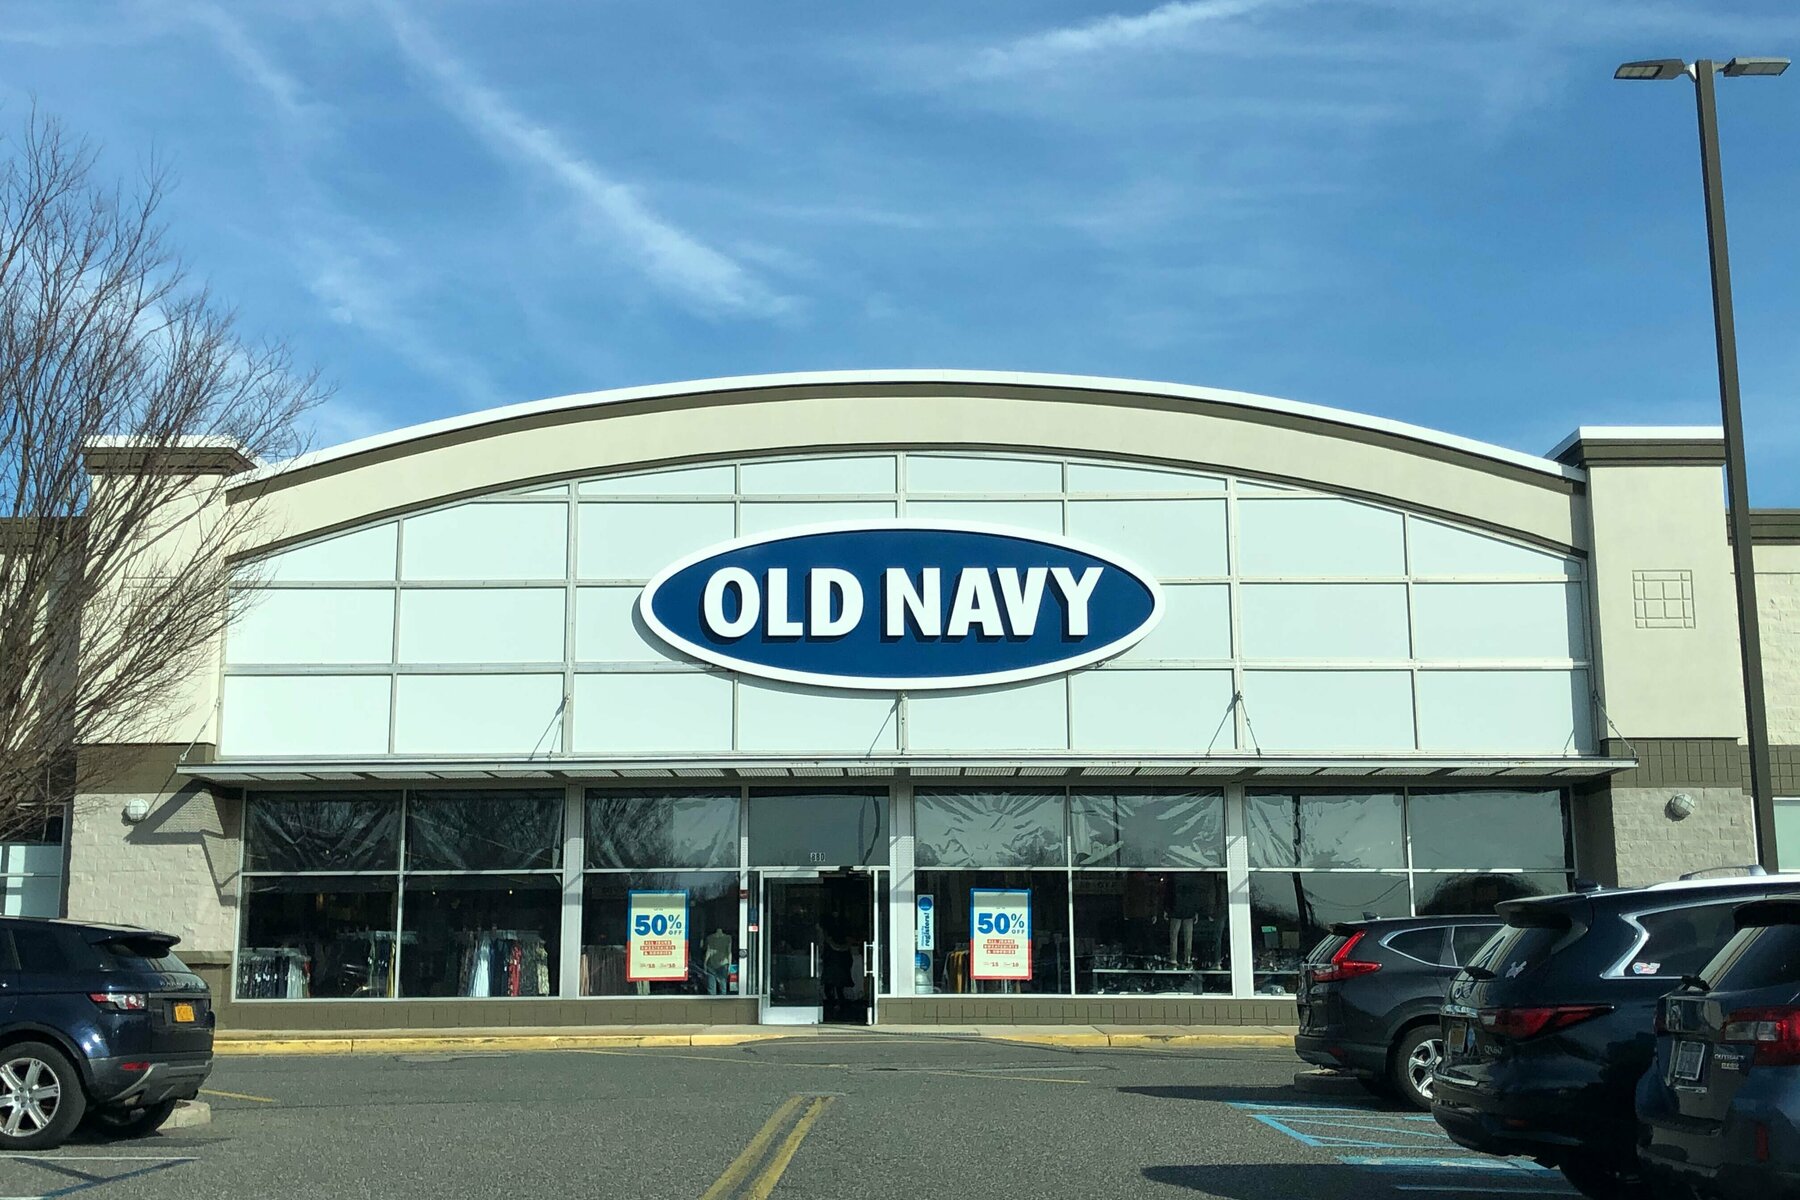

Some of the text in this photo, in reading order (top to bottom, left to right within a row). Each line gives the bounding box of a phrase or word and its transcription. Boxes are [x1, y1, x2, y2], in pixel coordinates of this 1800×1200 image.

[703, 566, 1105, 638] OLD NAVY
[634, 914, 682, 936] 50%
[977, 912, 1025, 935] 50%
